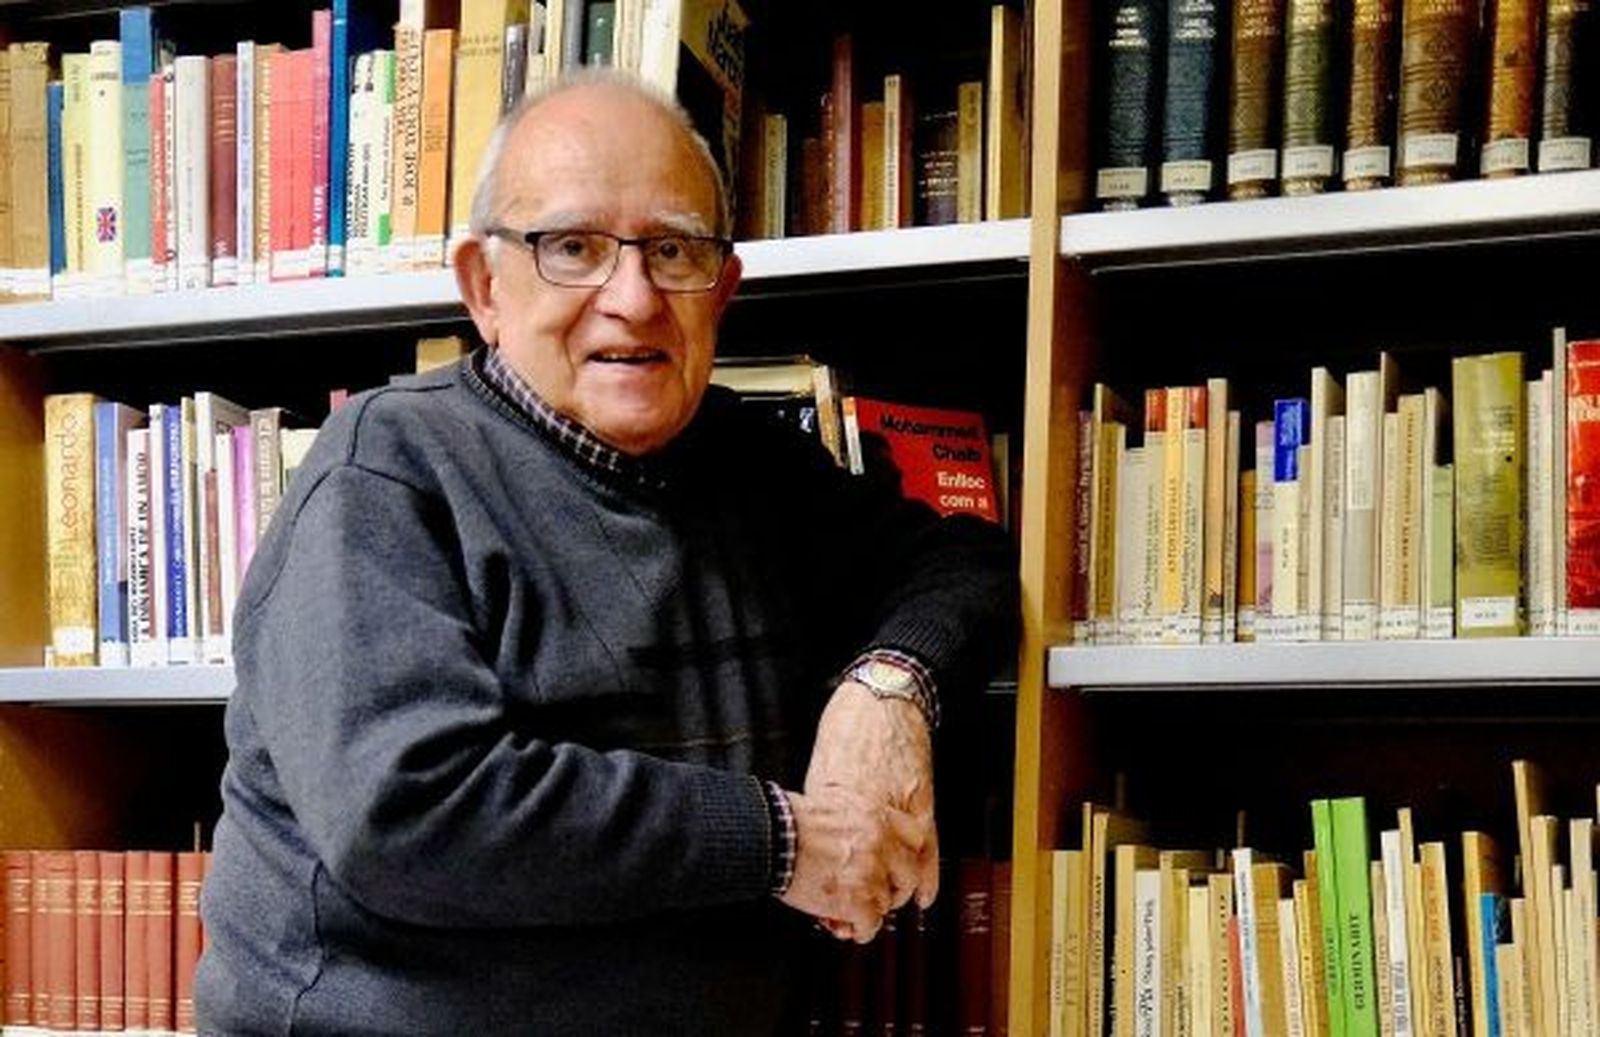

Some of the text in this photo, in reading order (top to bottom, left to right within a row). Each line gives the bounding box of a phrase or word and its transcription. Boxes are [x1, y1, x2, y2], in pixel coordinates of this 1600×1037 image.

[55, 412, 79, 541] Leonardo
[936, 471, 985, 489] Enlloc
[939, 494, 988, 509] com a
